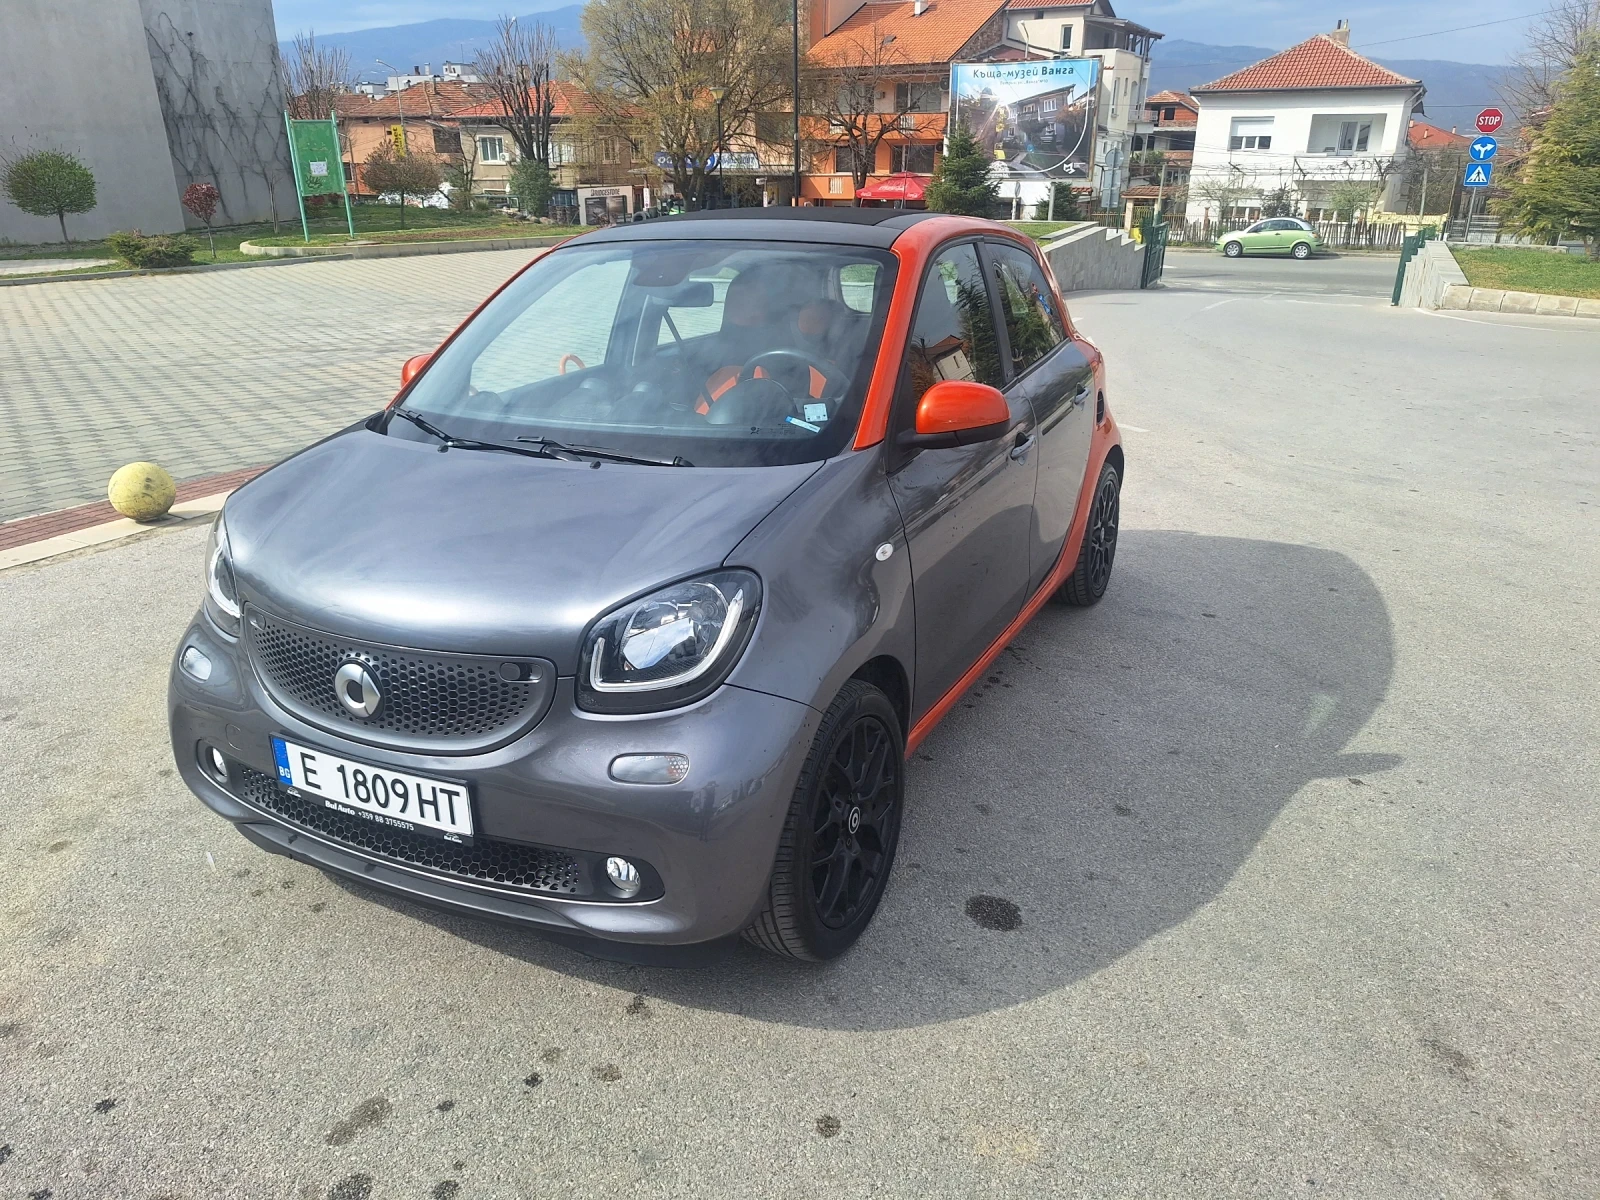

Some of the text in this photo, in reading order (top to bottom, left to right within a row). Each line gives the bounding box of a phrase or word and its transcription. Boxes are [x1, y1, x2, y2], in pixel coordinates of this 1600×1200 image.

[973, 66, 1074, 79] Къща-музей Ванга
[1478, 116, 1501, 126] STOP
[590, 188, 621, 197] BRIDGESTONE
[278, 766, 291, 779] BG
[300, 751, 461, 827] E 1809 HT
[325, 800, 337, 810] Bul
[337, 804, 356, 816] Auto
[358, 811, 373, 820] +359
[375, 815, 384, 823] 88
